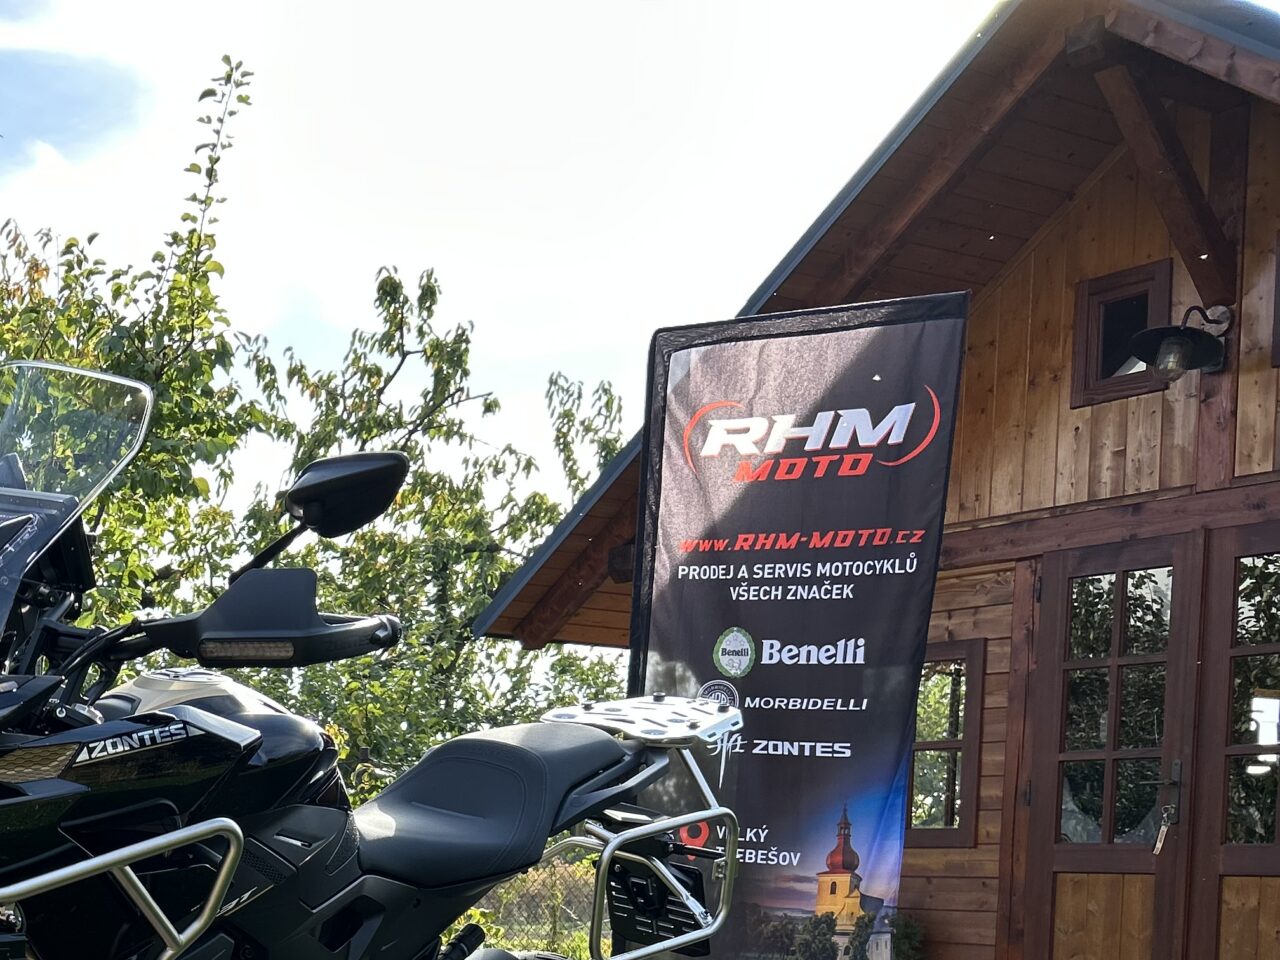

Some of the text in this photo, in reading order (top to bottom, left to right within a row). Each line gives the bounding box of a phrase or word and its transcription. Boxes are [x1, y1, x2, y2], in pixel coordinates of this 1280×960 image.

[700, 402, 916, 458] RHM
[733, 453, 874, 483] MOTO
[677, 552, 918, 580] PRODEJ A SERVIS MOTOCYKLŮ
[729, 582, 854, 601] VŠECH ZNAČEK
[721, 647, 749, 657] Benelli
[760, 638, 866, 665] Benelli
[744, 696, 868, 711] MORBIDELLI
[89, 723, 187, 759] ZONTES
[752, 739, 851, 757] ZONTES
